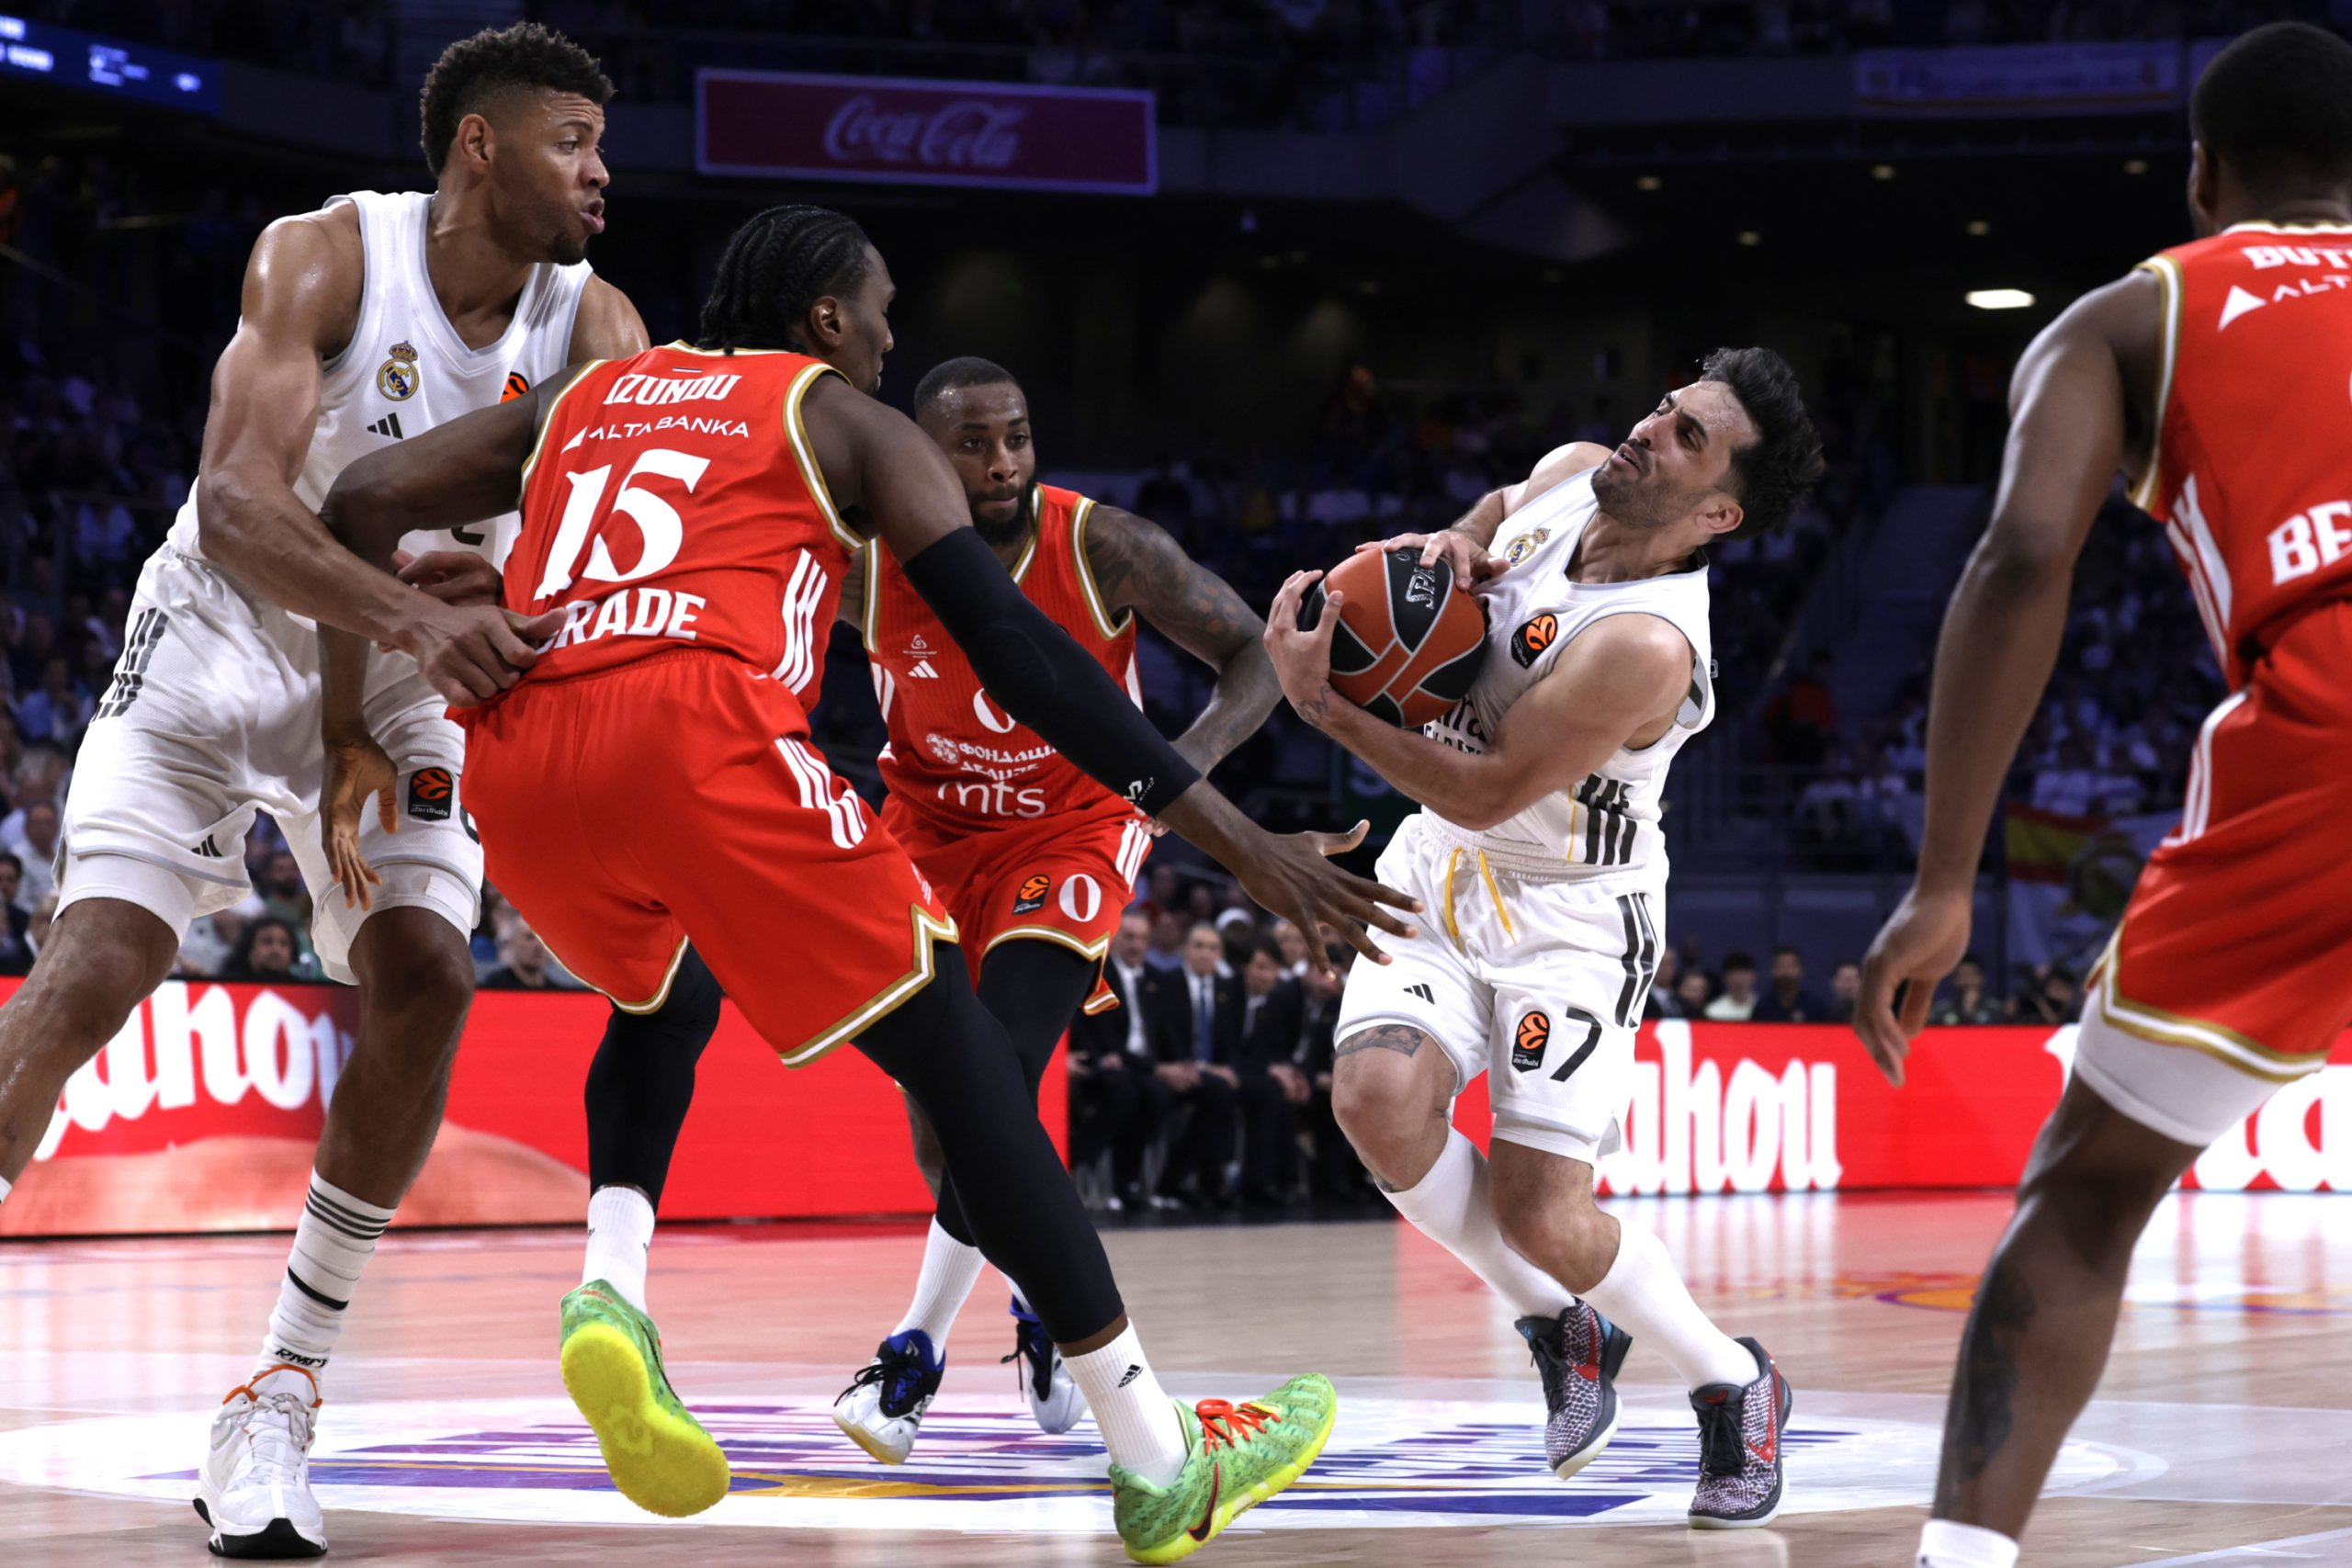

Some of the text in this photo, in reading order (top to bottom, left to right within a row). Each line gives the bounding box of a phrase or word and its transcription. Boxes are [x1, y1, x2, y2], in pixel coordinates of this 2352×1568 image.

[603, 374, 742, 405] IZUNDU
[533, 448, 711, 602] 15
[536, 587, 706, 655] RADE
[938, 780, 1046, 818] mts
[1058, 874, 1102, 922] 0
[1549, 1006, 1603, 1083] 7
